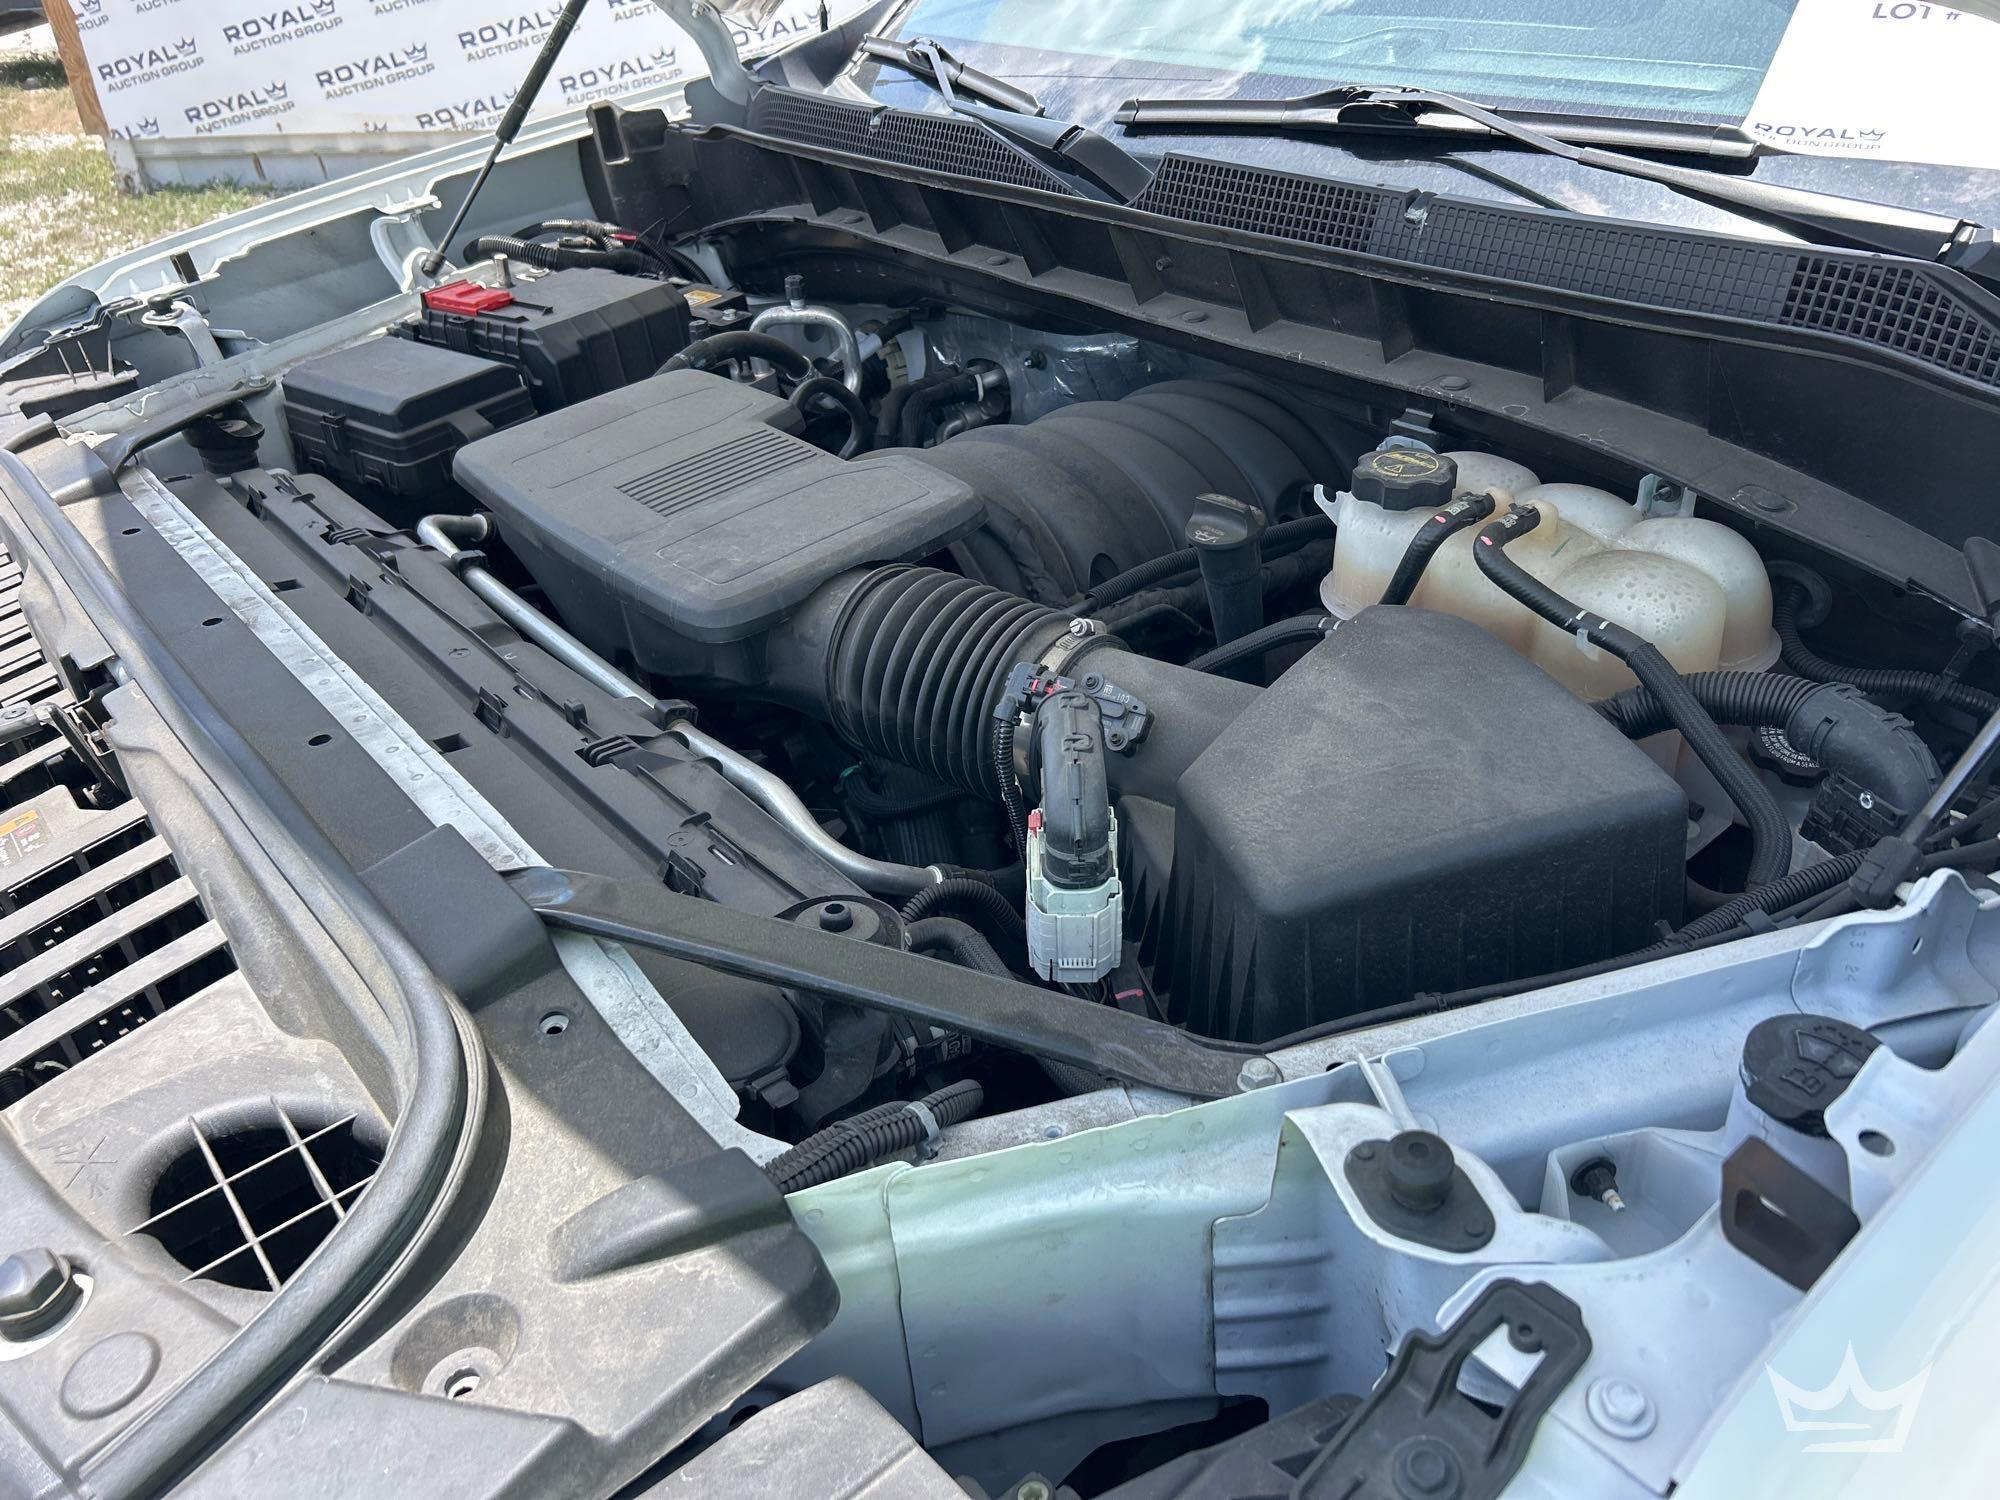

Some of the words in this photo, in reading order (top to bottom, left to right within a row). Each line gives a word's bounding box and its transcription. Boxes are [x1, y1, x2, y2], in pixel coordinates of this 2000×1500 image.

[79, 14, 109, 30] ROUP
[223, 6, 314, 43] ROYAL
[614, 3, 657, 22] AUCTI
[1872, 3, 1931, 20] LOT
[233, 31, 292, 56] AUCTION
[294, 16, 343, 38] GROUP
[458, 12, 552, 49] ROYAL
[732, 17, 808, 46] OYAL
[98, 46, 178, 81] ROYAL
[467, 38, 529, 62] AUCTION
[108, 70, 160, 93] AUCTION
[161, 56, 204, 78] GROUP
[315, 52, 406, 88] ROYAL
[325, 76, 385, 100] AUCTION
[386, 63, 435, 84] GROUP
[560, 58, 654, 93] ROYAL
[566, 81, 630, 105] AUCTION
[631, 68, 683, 89] GROUP
[184, 90, 268, 123] ROYAL
[195, 111, 250, 135] AUCTION
[252, 100, 296, 119] GROUP
[416, 95, 505, 129] ROYAL
[1755, 123, 1855, 139] ROYAL
